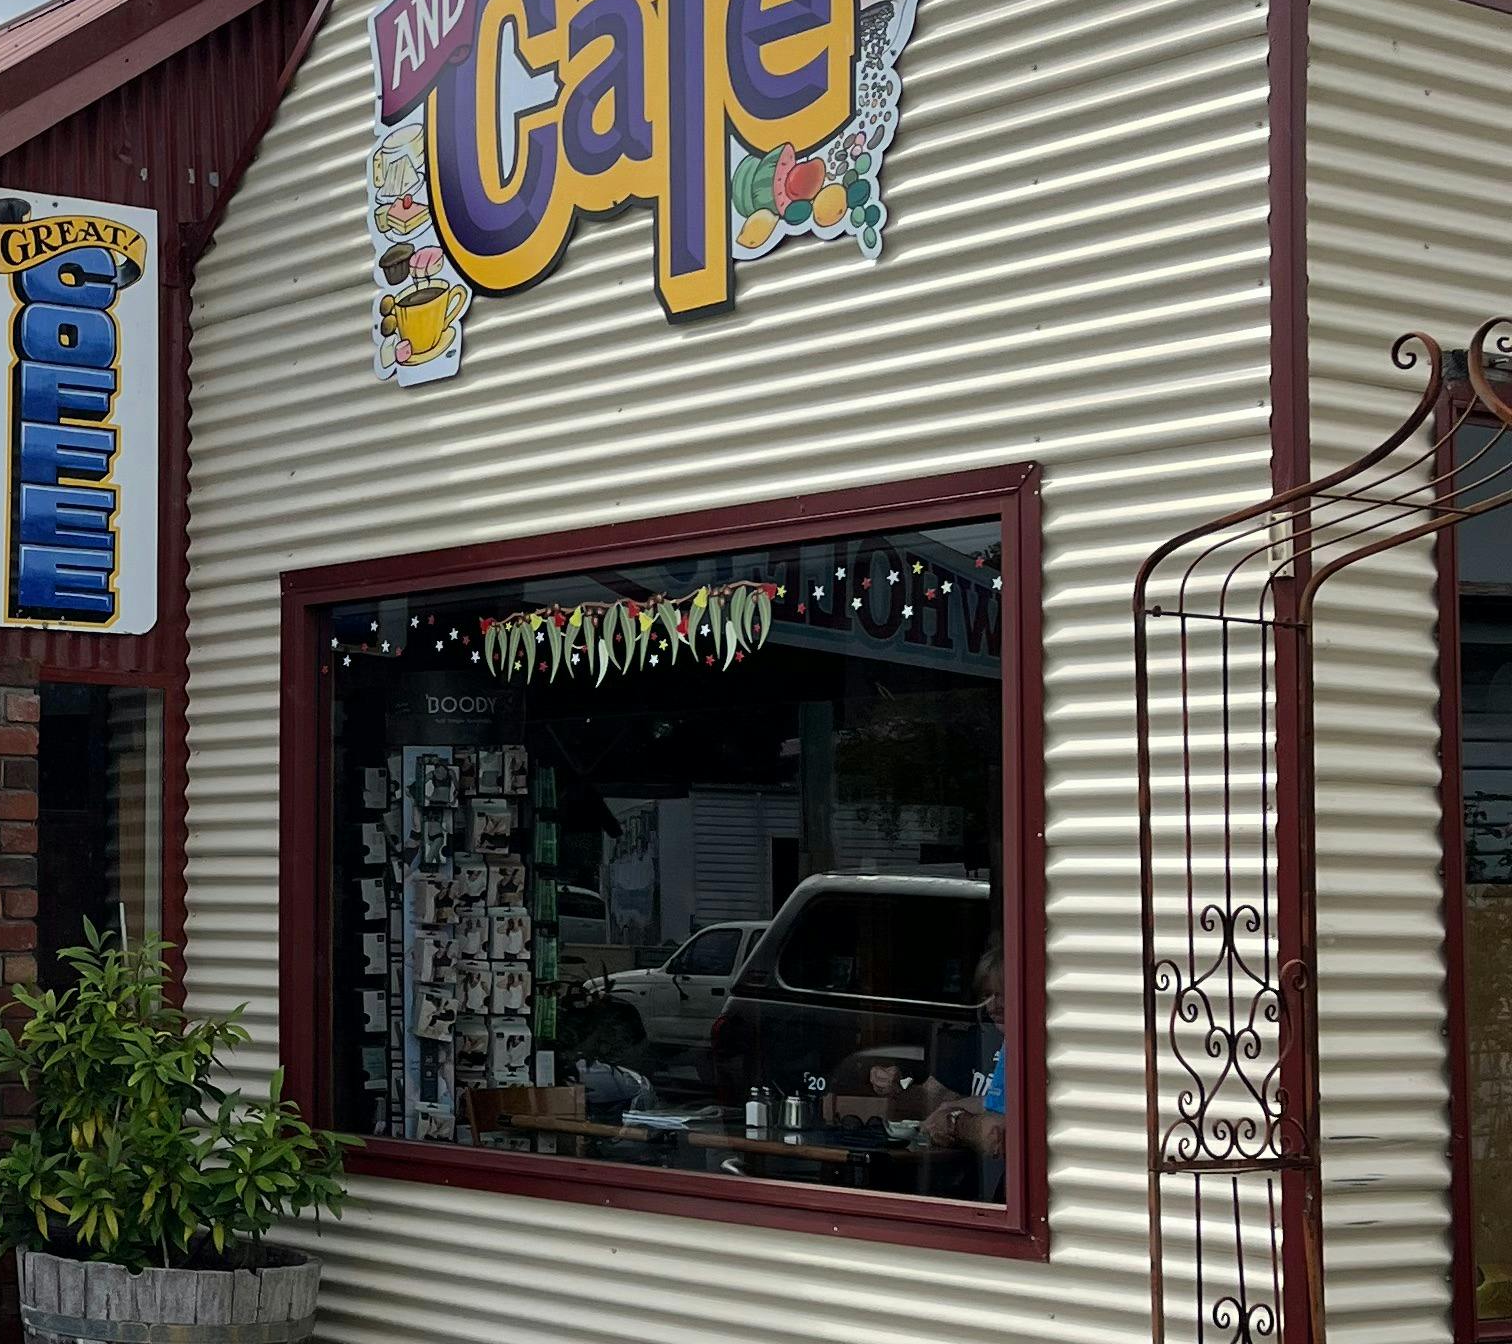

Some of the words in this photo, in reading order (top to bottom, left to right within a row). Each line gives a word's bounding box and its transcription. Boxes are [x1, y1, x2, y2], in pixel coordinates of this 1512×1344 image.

[0, 220, 141, 266] GREAT!
[13, 247, 119, 618] COFFEE
[425, 694, 496, 714] BOODY
[807, 1076, 826, 1091] 20
